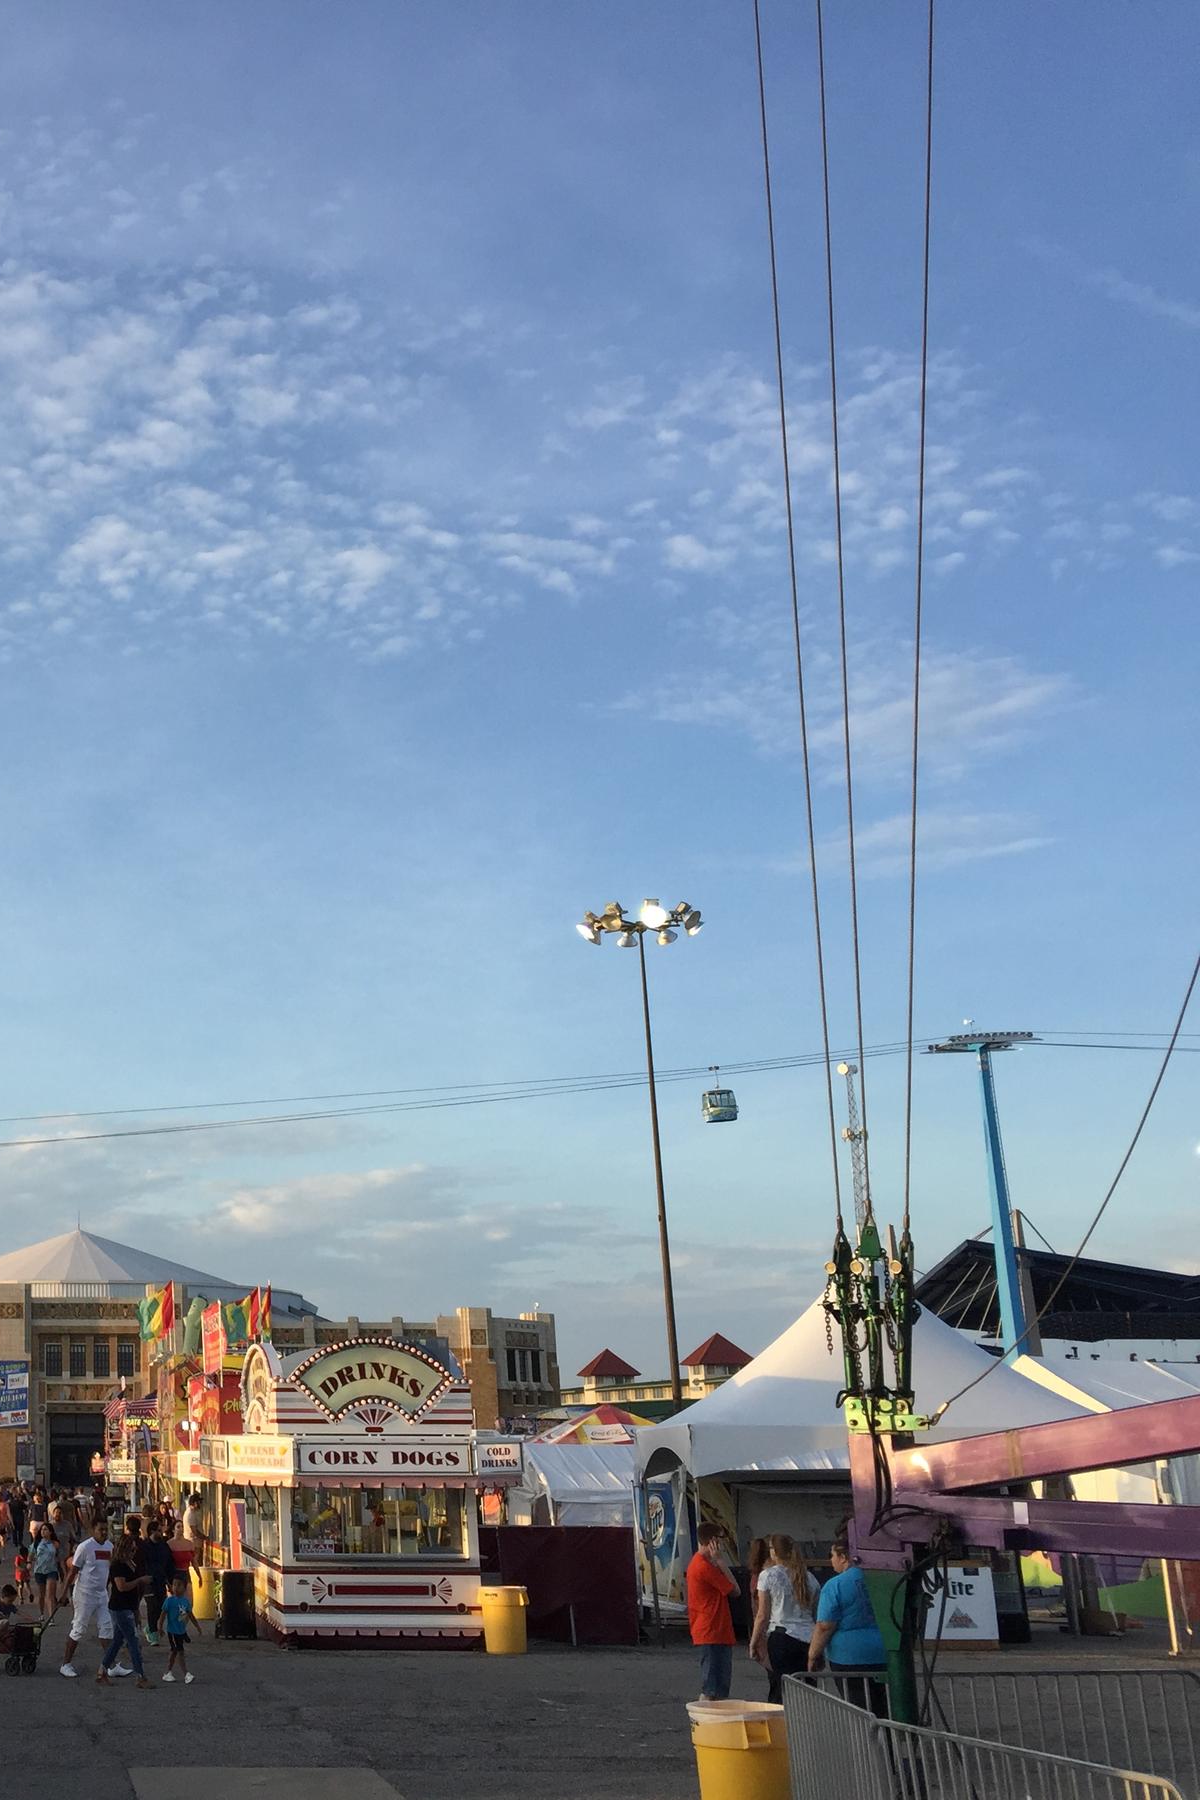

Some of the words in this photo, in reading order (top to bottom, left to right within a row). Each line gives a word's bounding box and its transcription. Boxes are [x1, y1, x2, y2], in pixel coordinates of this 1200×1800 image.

[318, 1362, 425, 1399] DRINKS
[244, 1446, 275, 1455] FRESH
[486, 1447, 511, 1456] COLD
[235, 1457, 285, 1466] LEMONADE
[308, 1451, 378, 1465] CORN
[392, 1451, 460, 1466] DOGS
[481, 1459, 518, 1469] DRINKS
